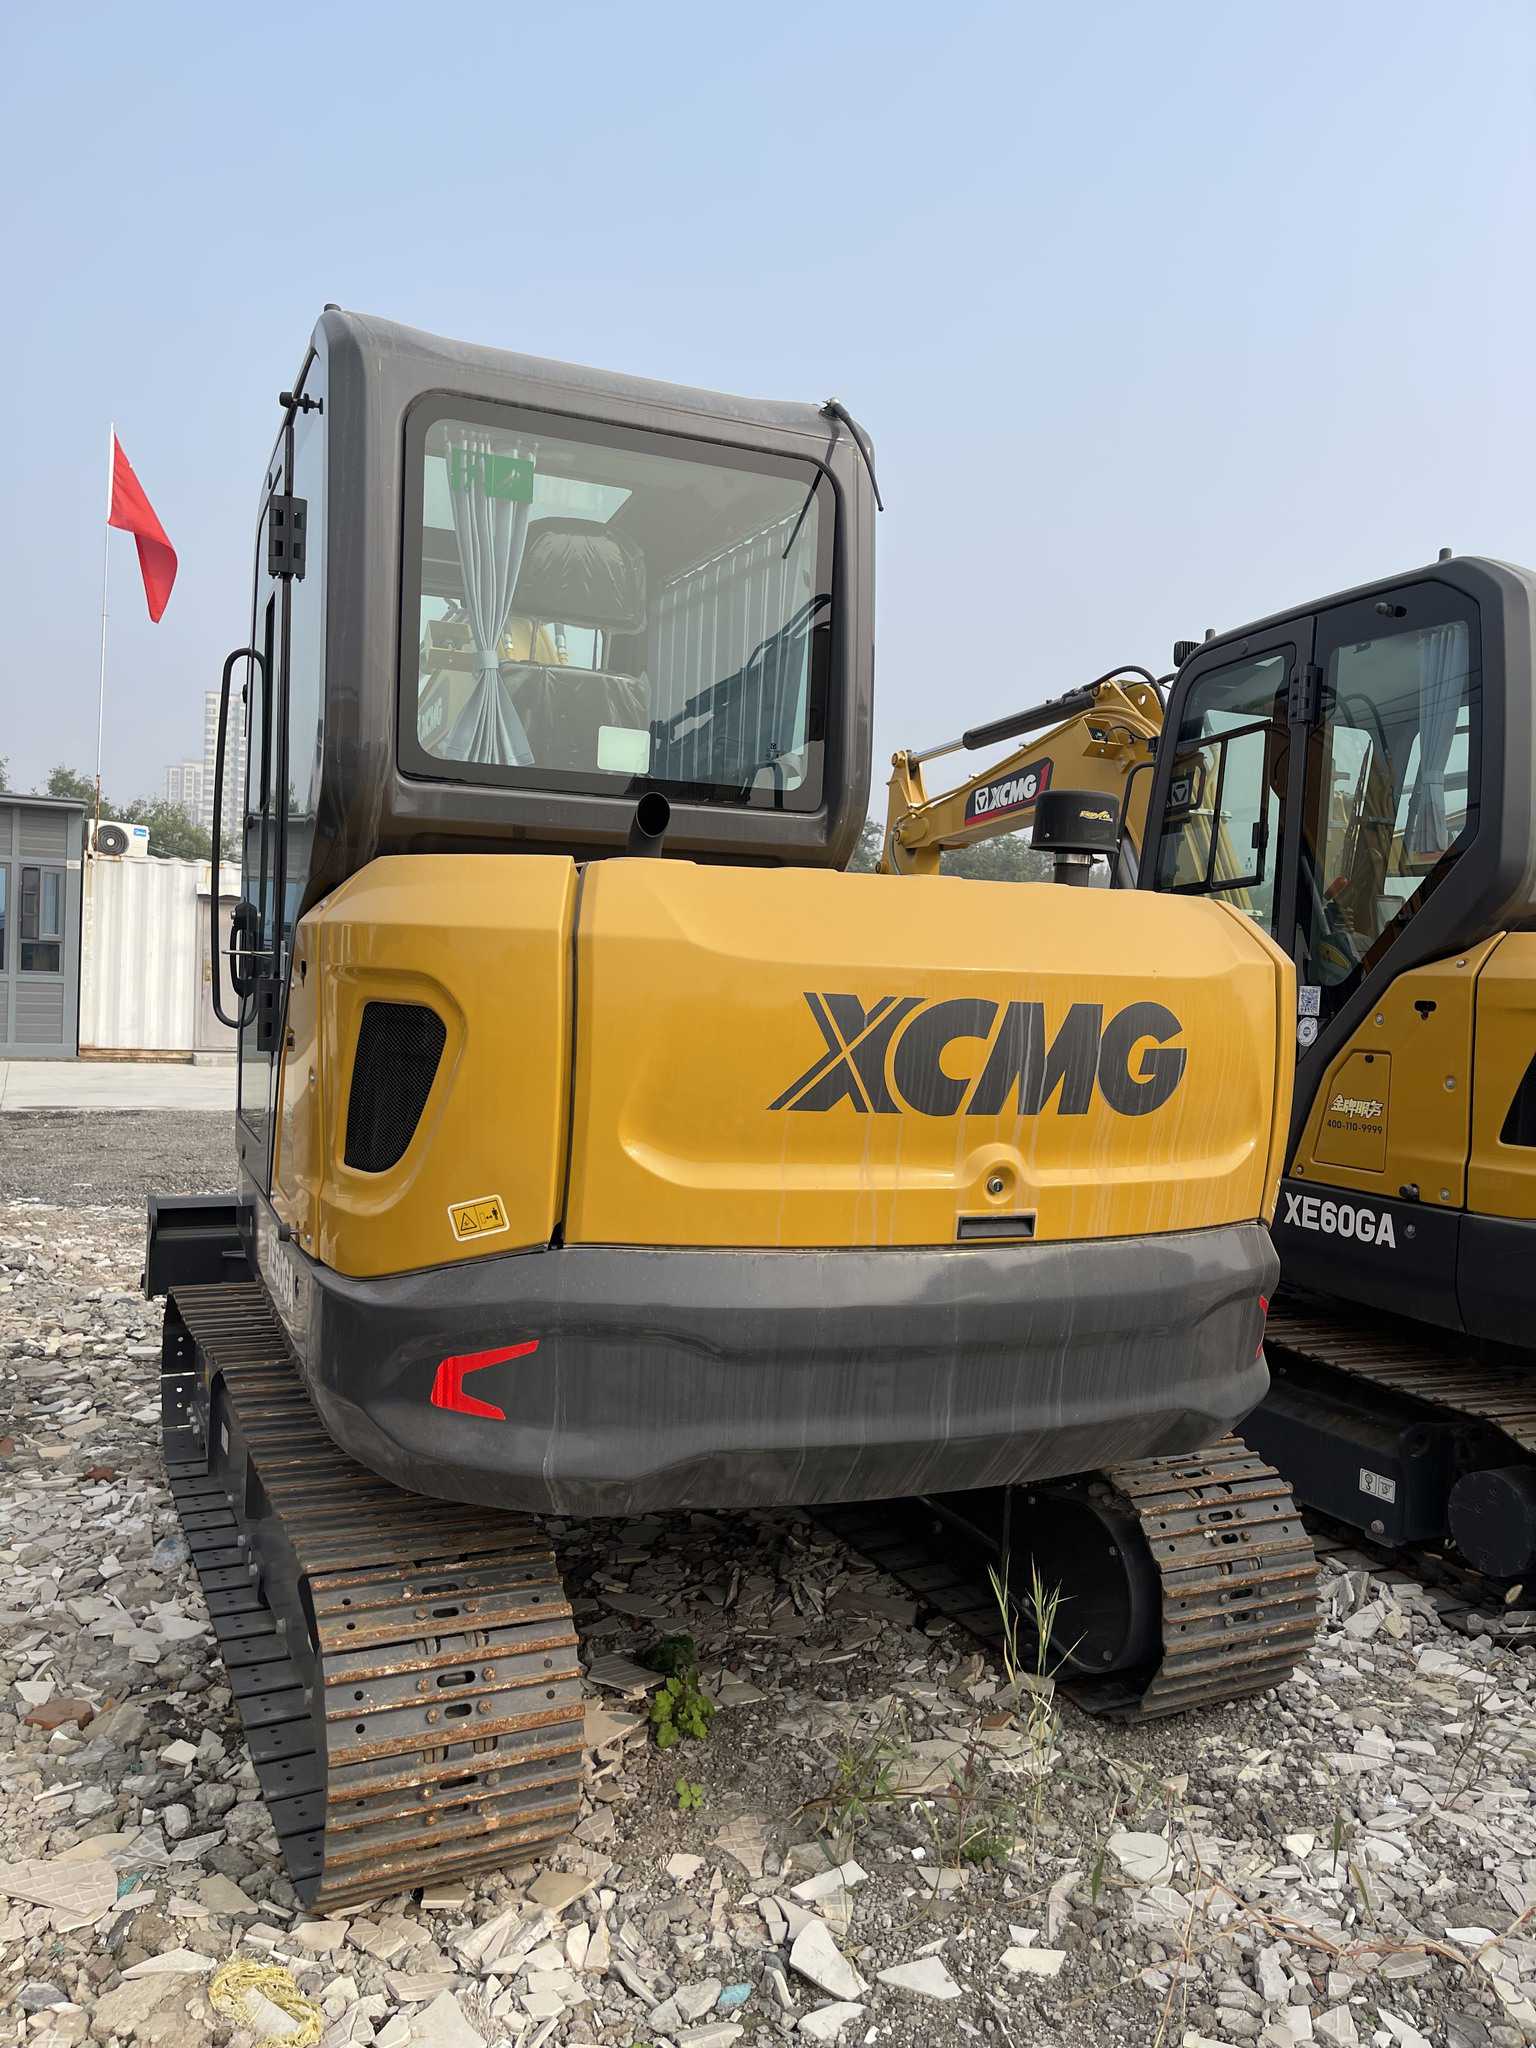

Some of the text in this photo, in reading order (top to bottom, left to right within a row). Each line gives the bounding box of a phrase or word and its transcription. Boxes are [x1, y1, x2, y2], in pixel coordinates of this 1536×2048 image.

[989, 774, 1037, 809] XCMG
[766, 992, 1187, 1116] XCMG
[1330, 1094, 1383, 1119] 金牌服务
[1327, 1119, 1383, 1135] 400-110-9999
[1283, 1191, 1396, 1249] XE60GA
